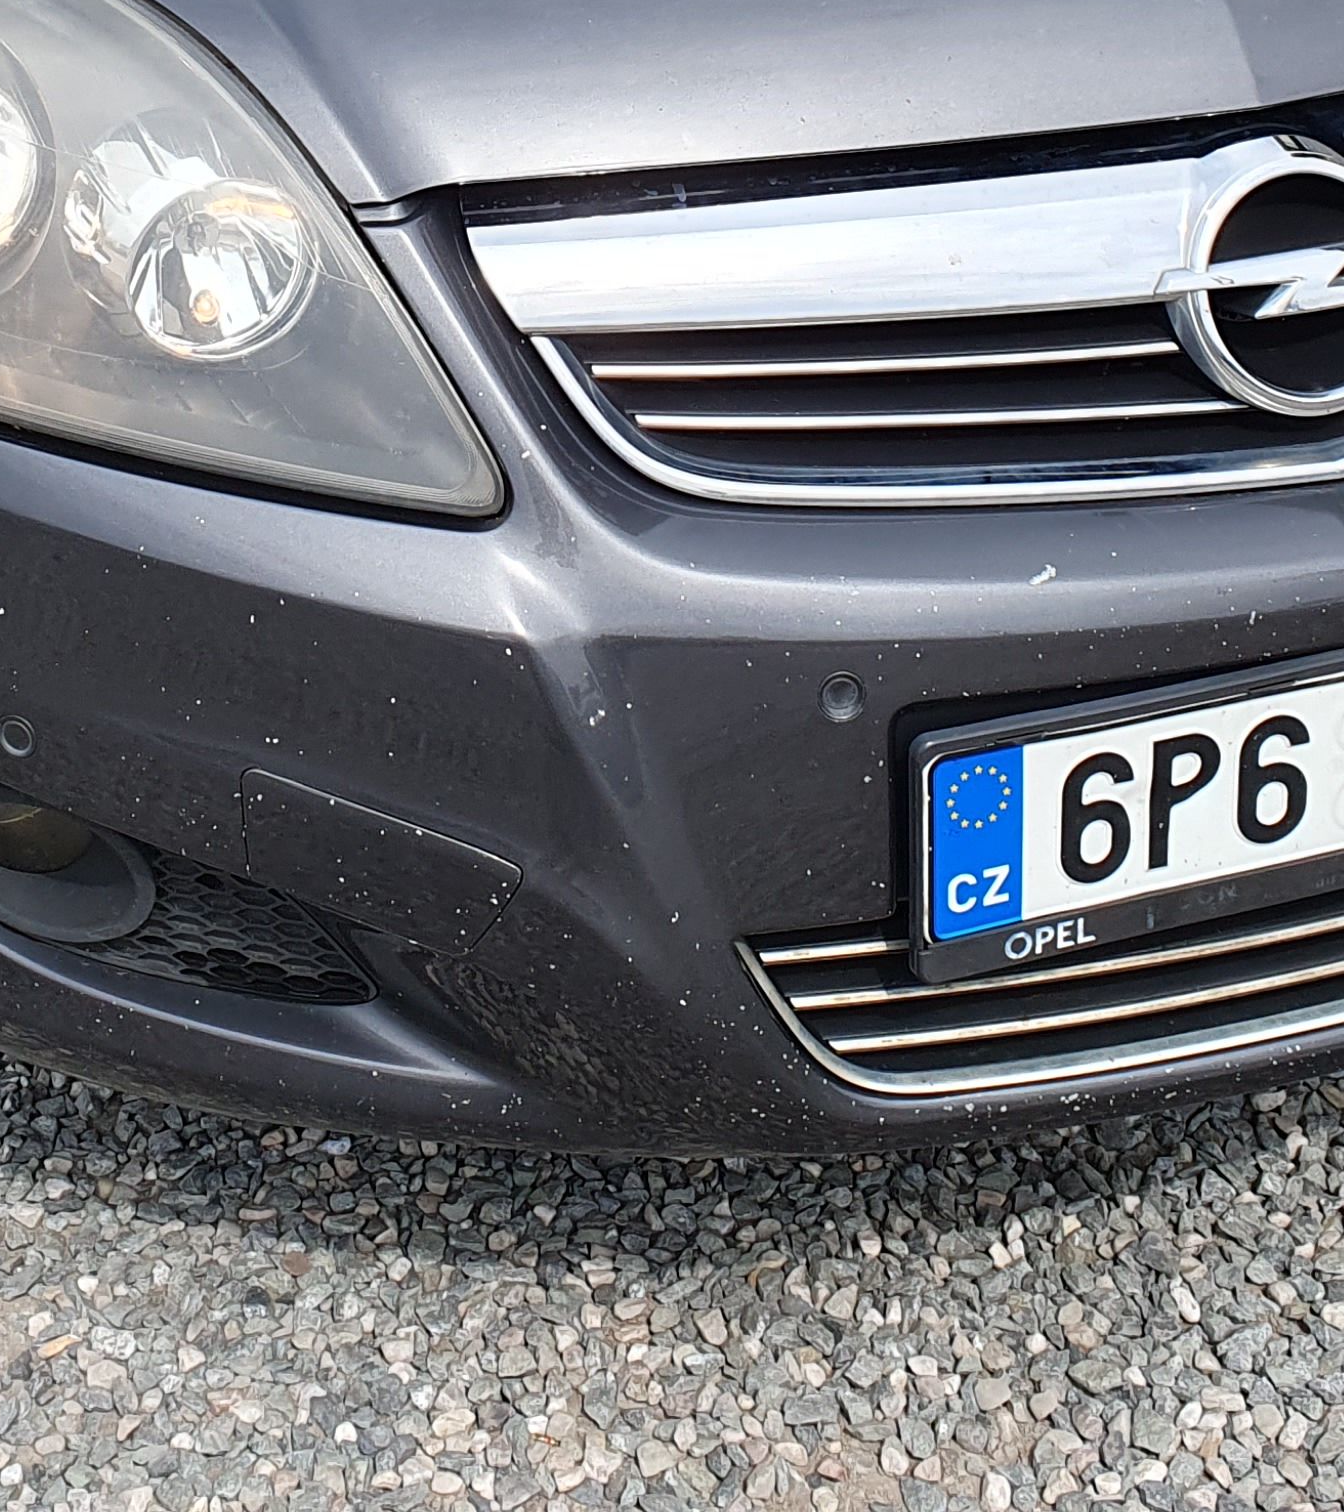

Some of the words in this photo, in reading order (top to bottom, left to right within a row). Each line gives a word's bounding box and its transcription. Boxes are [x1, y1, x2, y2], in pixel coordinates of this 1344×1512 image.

[1060, 714, 1311, 885] 6P6
[947, 864, 1010, 914] CZ
[1005, 916, 1097, 960] OPEL
